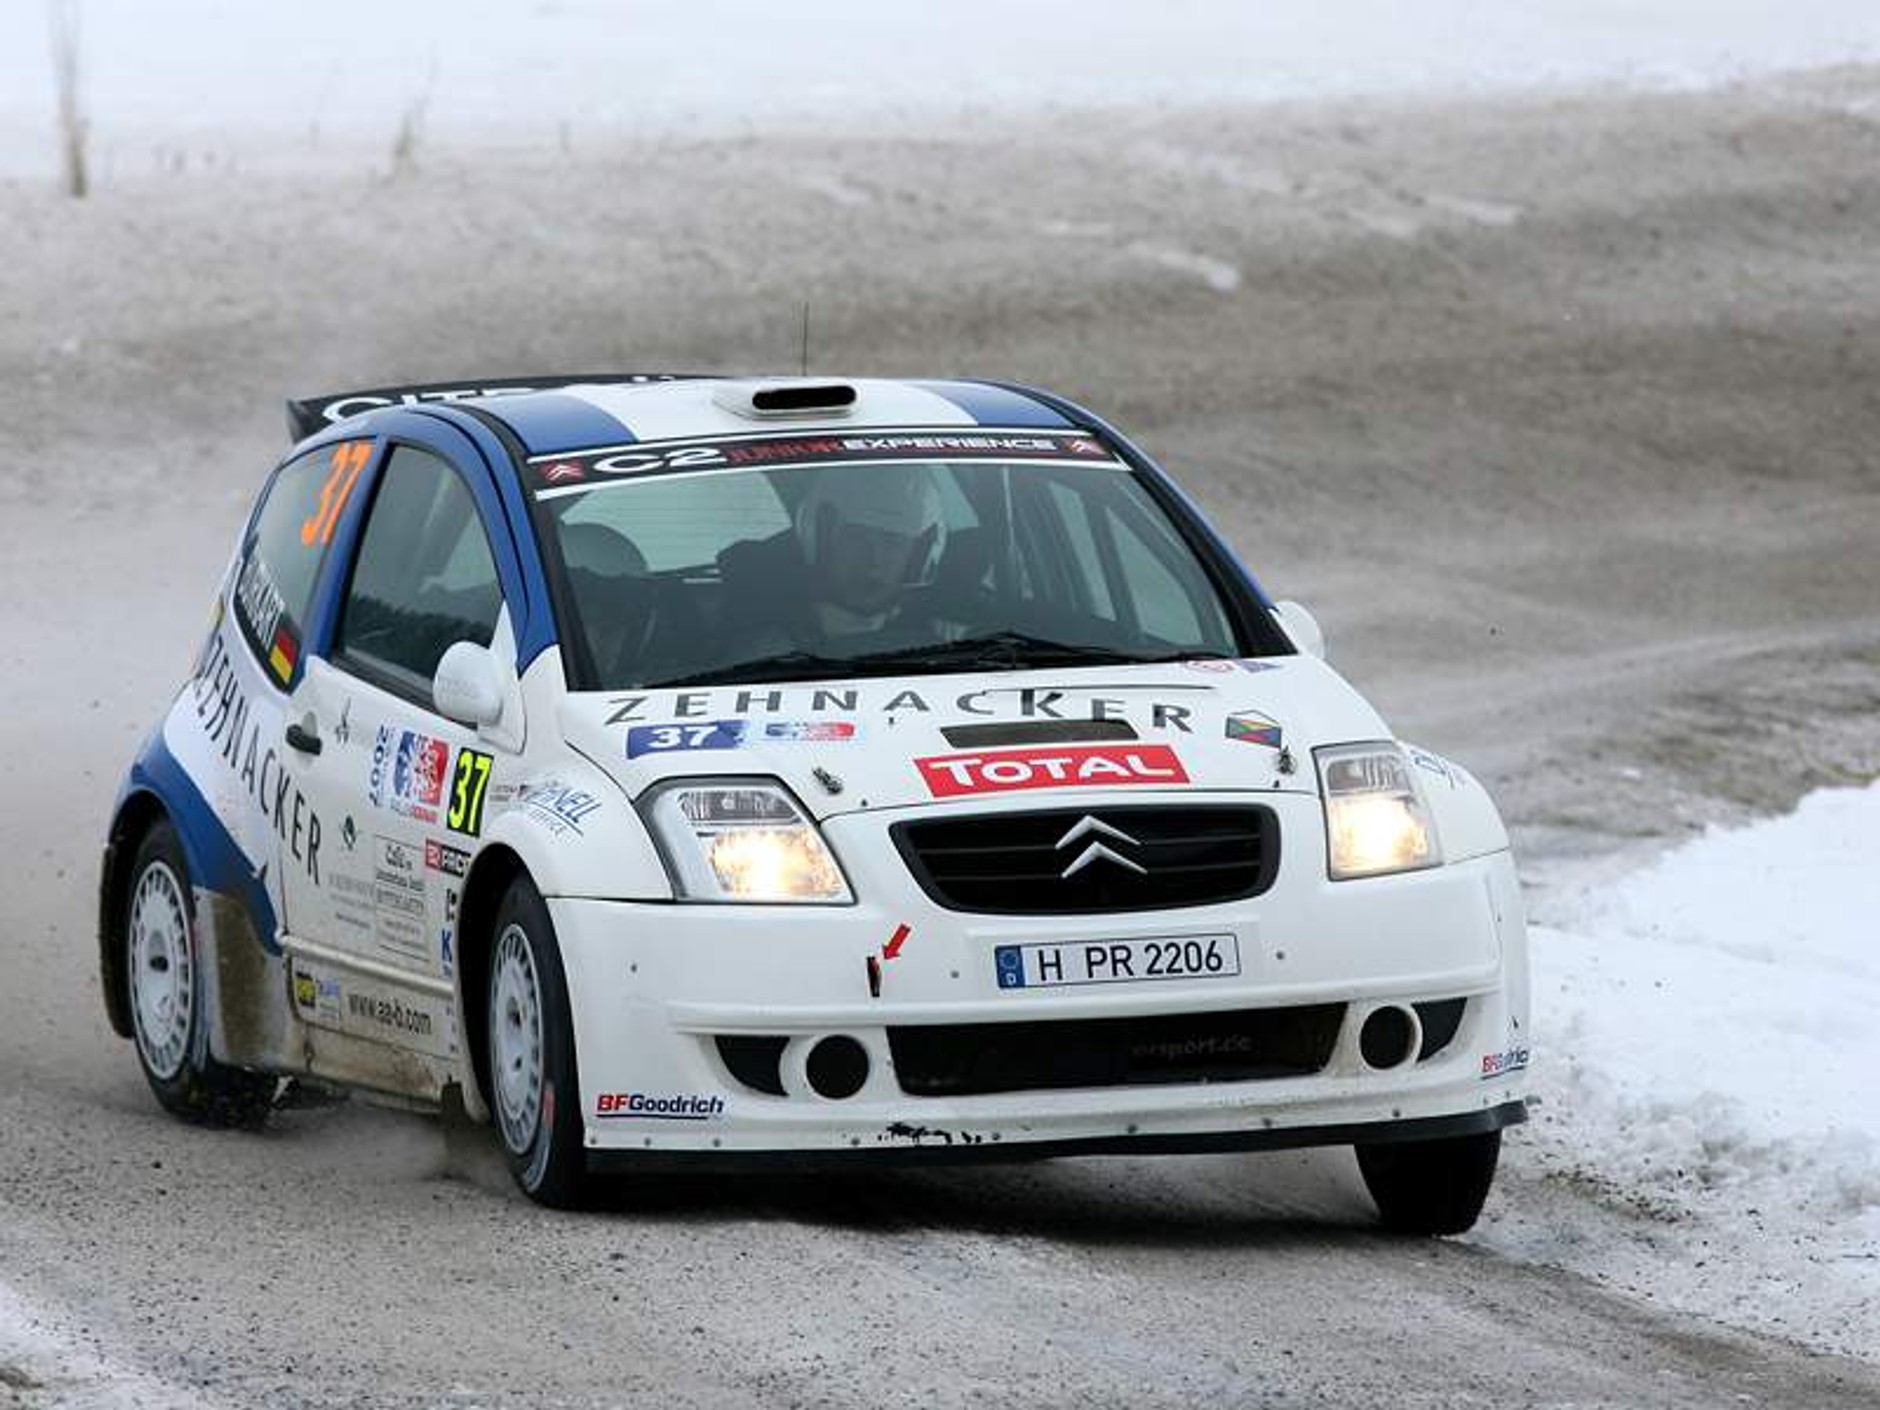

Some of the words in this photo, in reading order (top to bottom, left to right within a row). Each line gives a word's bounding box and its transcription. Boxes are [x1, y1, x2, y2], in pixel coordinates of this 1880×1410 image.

[594, 446, 728, 473] C2
[842, 436, 1059, 454] EXPERIENCE
[302, 441, 373, 547] 37
[604, 687, 1193, 734] ZEHNACKER
[646, 727, 719, 749] 37
[930, 754, 1174, 787] TOTAL
[451, 751, 491, 833] 37
[1038, 949, 1063, 981] H
[1085, 945, 1134, 979] PR
[1144, 940, 1223, 975] 2206
[596, 1093, 725, 1114] BFGoodrich
